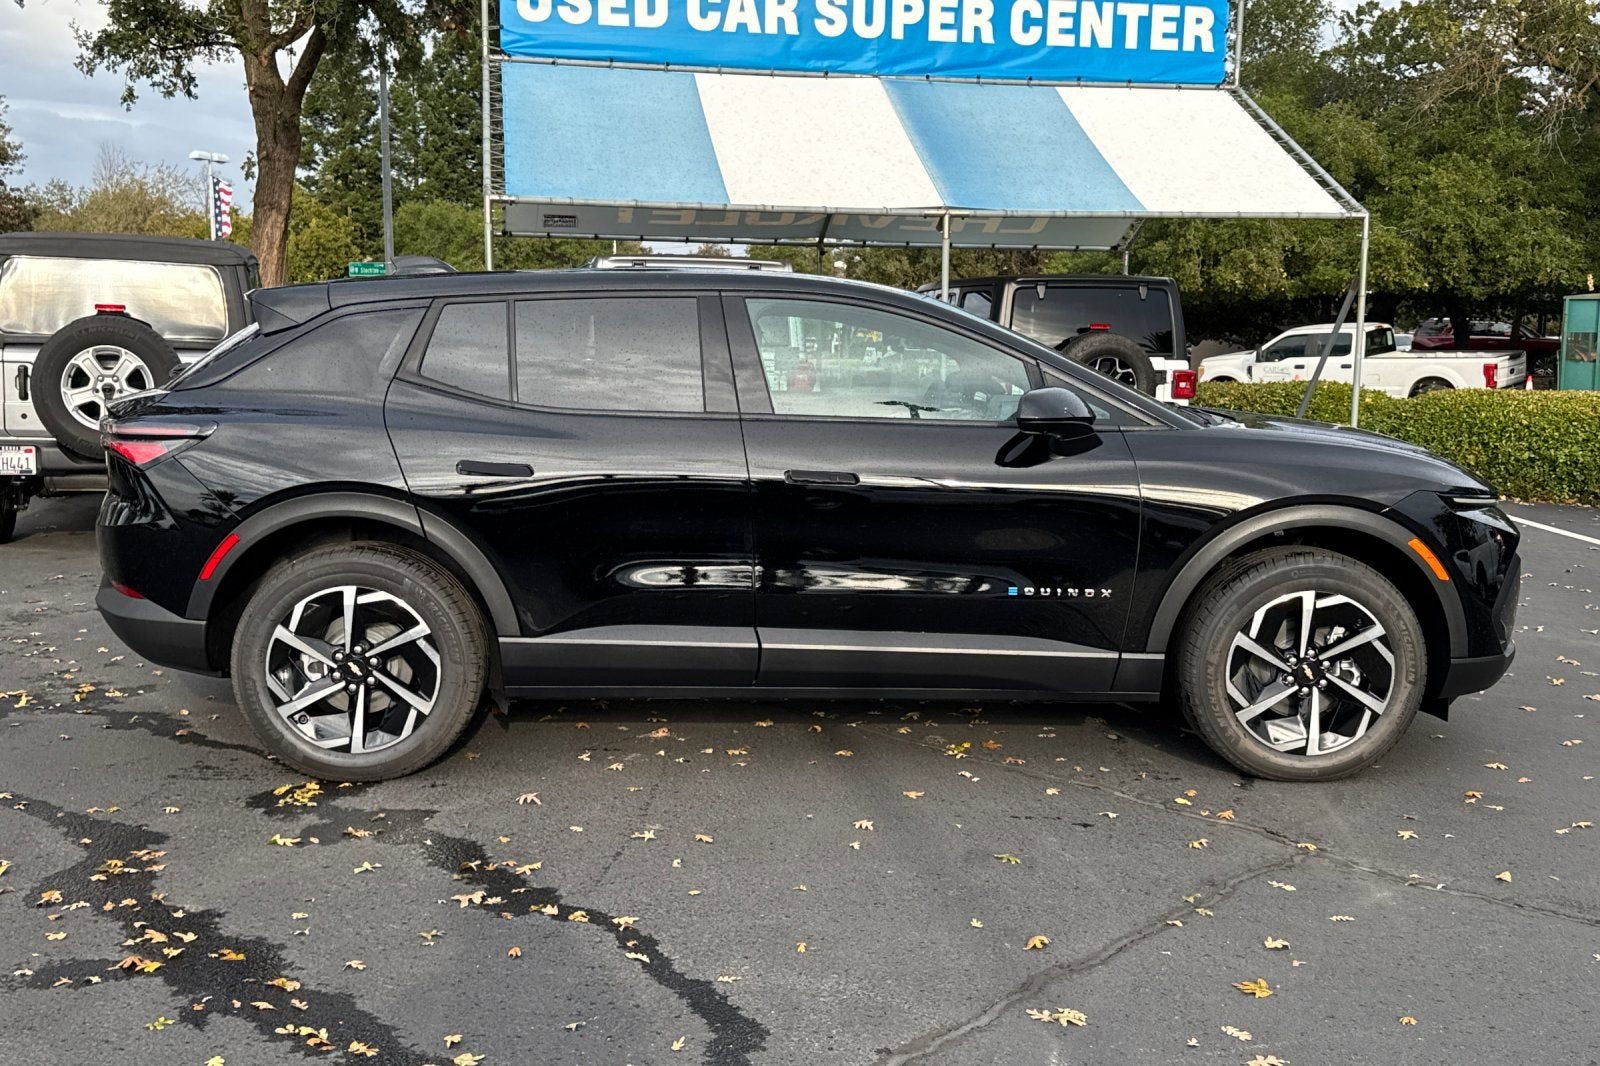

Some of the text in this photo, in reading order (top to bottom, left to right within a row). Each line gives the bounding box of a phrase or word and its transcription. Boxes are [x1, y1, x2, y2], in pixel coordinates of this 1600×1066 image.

[687, 0, 800, 36] CAR
[813, 0, 995, 45] SUPER
[1010, 0, 1216, 54] CENTER
[1007, 586, 1113, 598] EQUINOX
